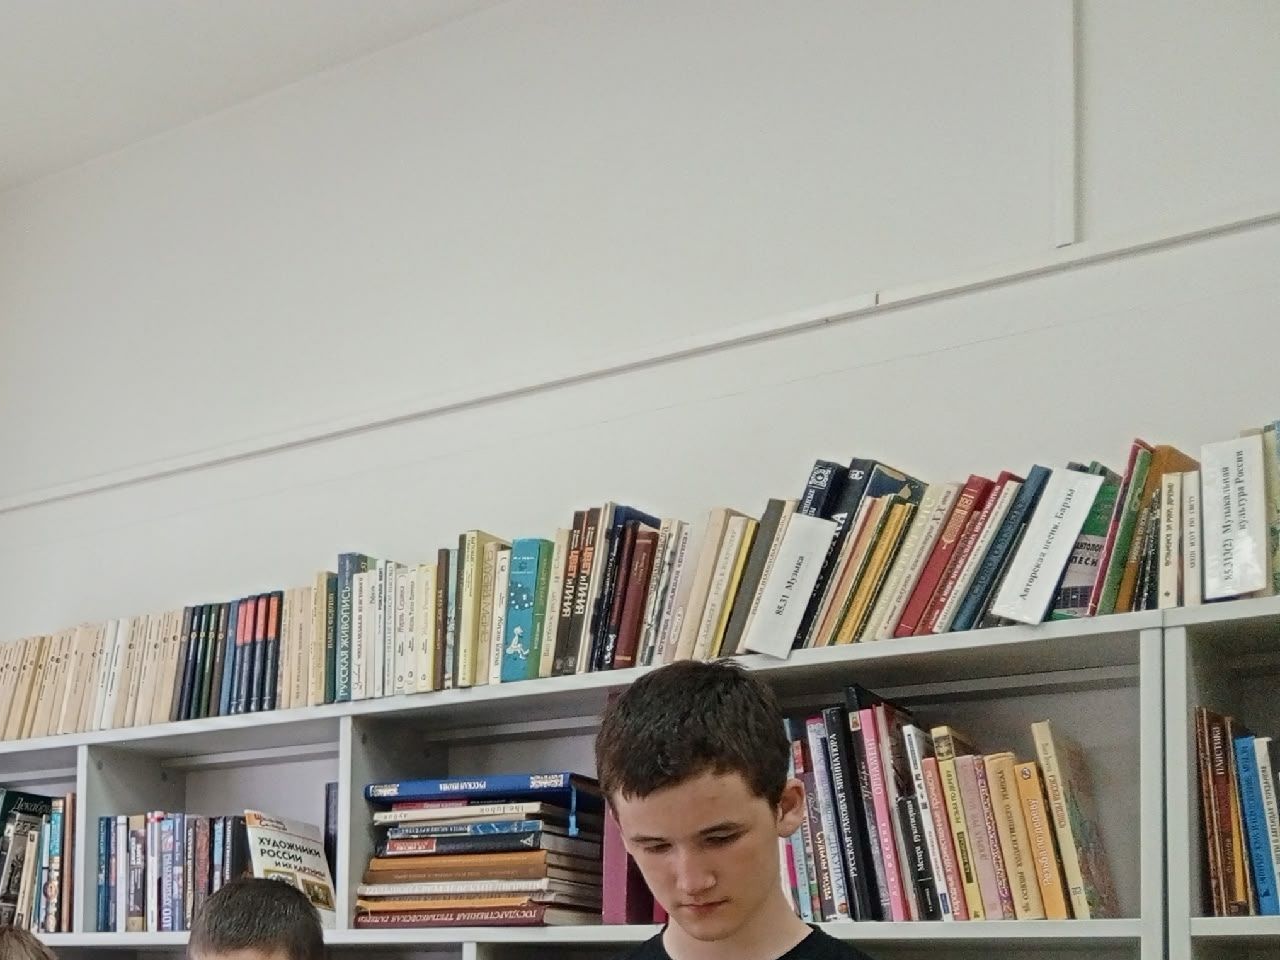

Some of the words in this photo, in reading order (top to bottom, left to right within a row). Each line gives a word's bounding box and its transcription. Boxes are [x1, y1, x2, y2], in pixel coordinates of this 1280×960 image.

[1235, 450, 1244, 483] России
[1220, 466, 1233, 533] Музыкальная
[1238, 486, 1247, 529] культура
[580, 546, 593, 575] ЦВЕТ
[1018, 549, 1049, 601] Авторская
[1054, 486, 1078, 520] Барды
[566, 549, 579, 579] ЦВЕТ
[561, 584, 574, 618] ЛИНИЯ
[574, 580, 588, 615] ЛИНИЯ
[774, 593, 789, 616] 85.31
[783, 553, 805, 591] Музыка
[340, 586, 350, 647] ЖИВОПИСЬ
[339, 650, 349, 696] РУССКАЯ
[863, 735, 884, 795] ОРНАМЕНТ
[945, 768, 955, 791] ДЕРЕВУ
[461, 781, 486, 789] РУССКАЯ
[924, 768, 940, 808] промыслы
[951, 801, 961, 823] РЕЗЬБА
[1025, 797, 1044, 834] дереву
[257, 835, 321, 858] ХУДОЖНИКИ
[813, 831, 829, 870] Судьбы
[933, 808, 953, 872] художественные
[1004, 803, 1023, 867] ХУДОЖЕСТВЕННОГО
[1035, 835, 1044, 847] по
[259, 847, 303, 864] РОССИИ
[293, 864, 326, 877] КАРТИНЫ
[844, 835, 858, 877] РУССКАЯ
[1035, 850, 1051, 886] Резьба
[820, 871, 832, 900] моды
[946, 875, 960, 915] Народные
[357, 914, 389, 922] ГАЛЕРЕЯ
[389, 912, 454, 922] ТРЕТЬЯКОВСКАЯ
[456, 909, 536, 920] ГОСУДАРСТВЕННАЯ
